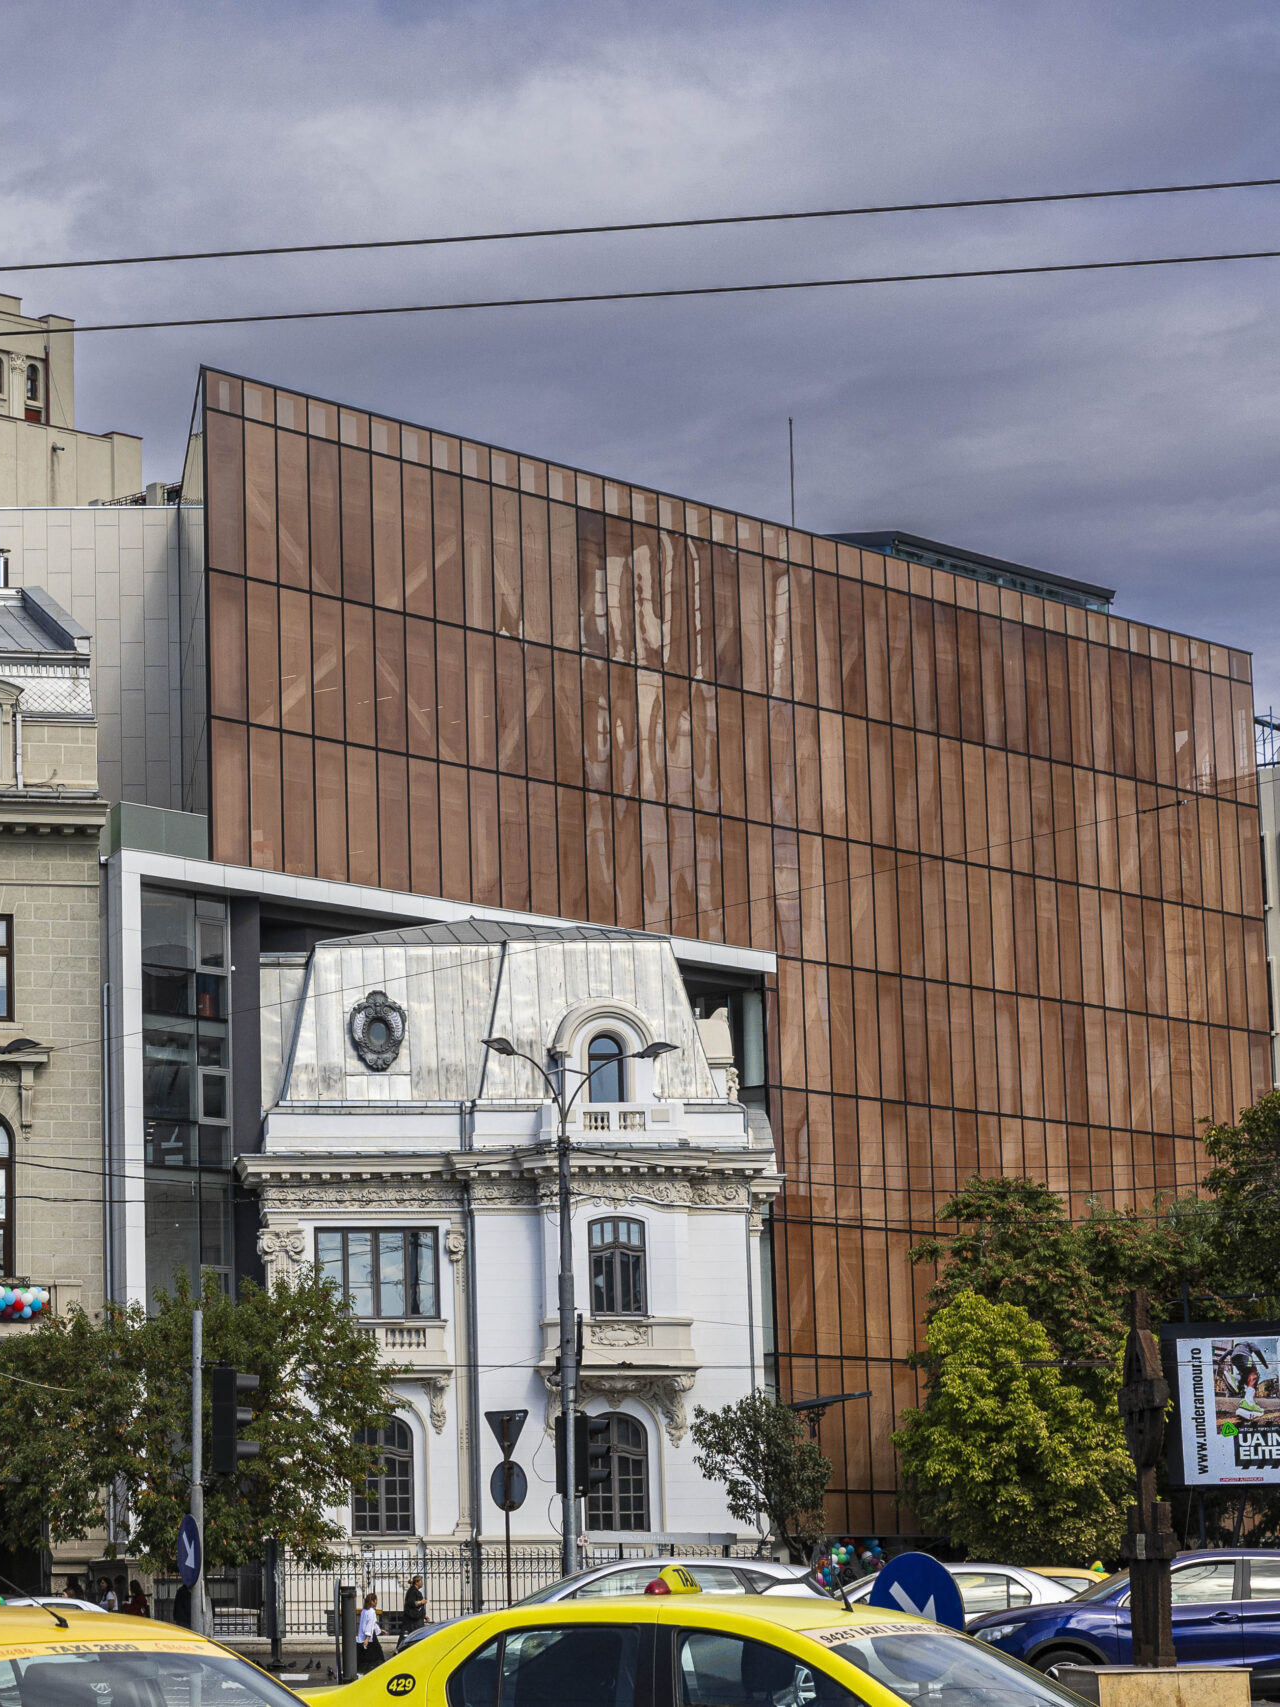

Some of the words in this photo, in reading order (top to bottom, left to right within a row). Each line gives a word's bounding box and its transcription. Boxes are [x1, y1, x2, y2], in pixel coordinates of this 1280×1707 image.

[1190, 1347, 1209, 1475] www.underarmour.ro
[1238, 1432, 1266, 1446] UA
[1239, 1446, 1280, 1460] ELITE
[820, 1629, 855, 1644] 9425
[851, 1625, 884, 1638] TAXI
[45, 1644, 93, 1654] TAXI
[93, 1643, 140, 1652] 2000
[388, 1678, 414, 1692] 429
